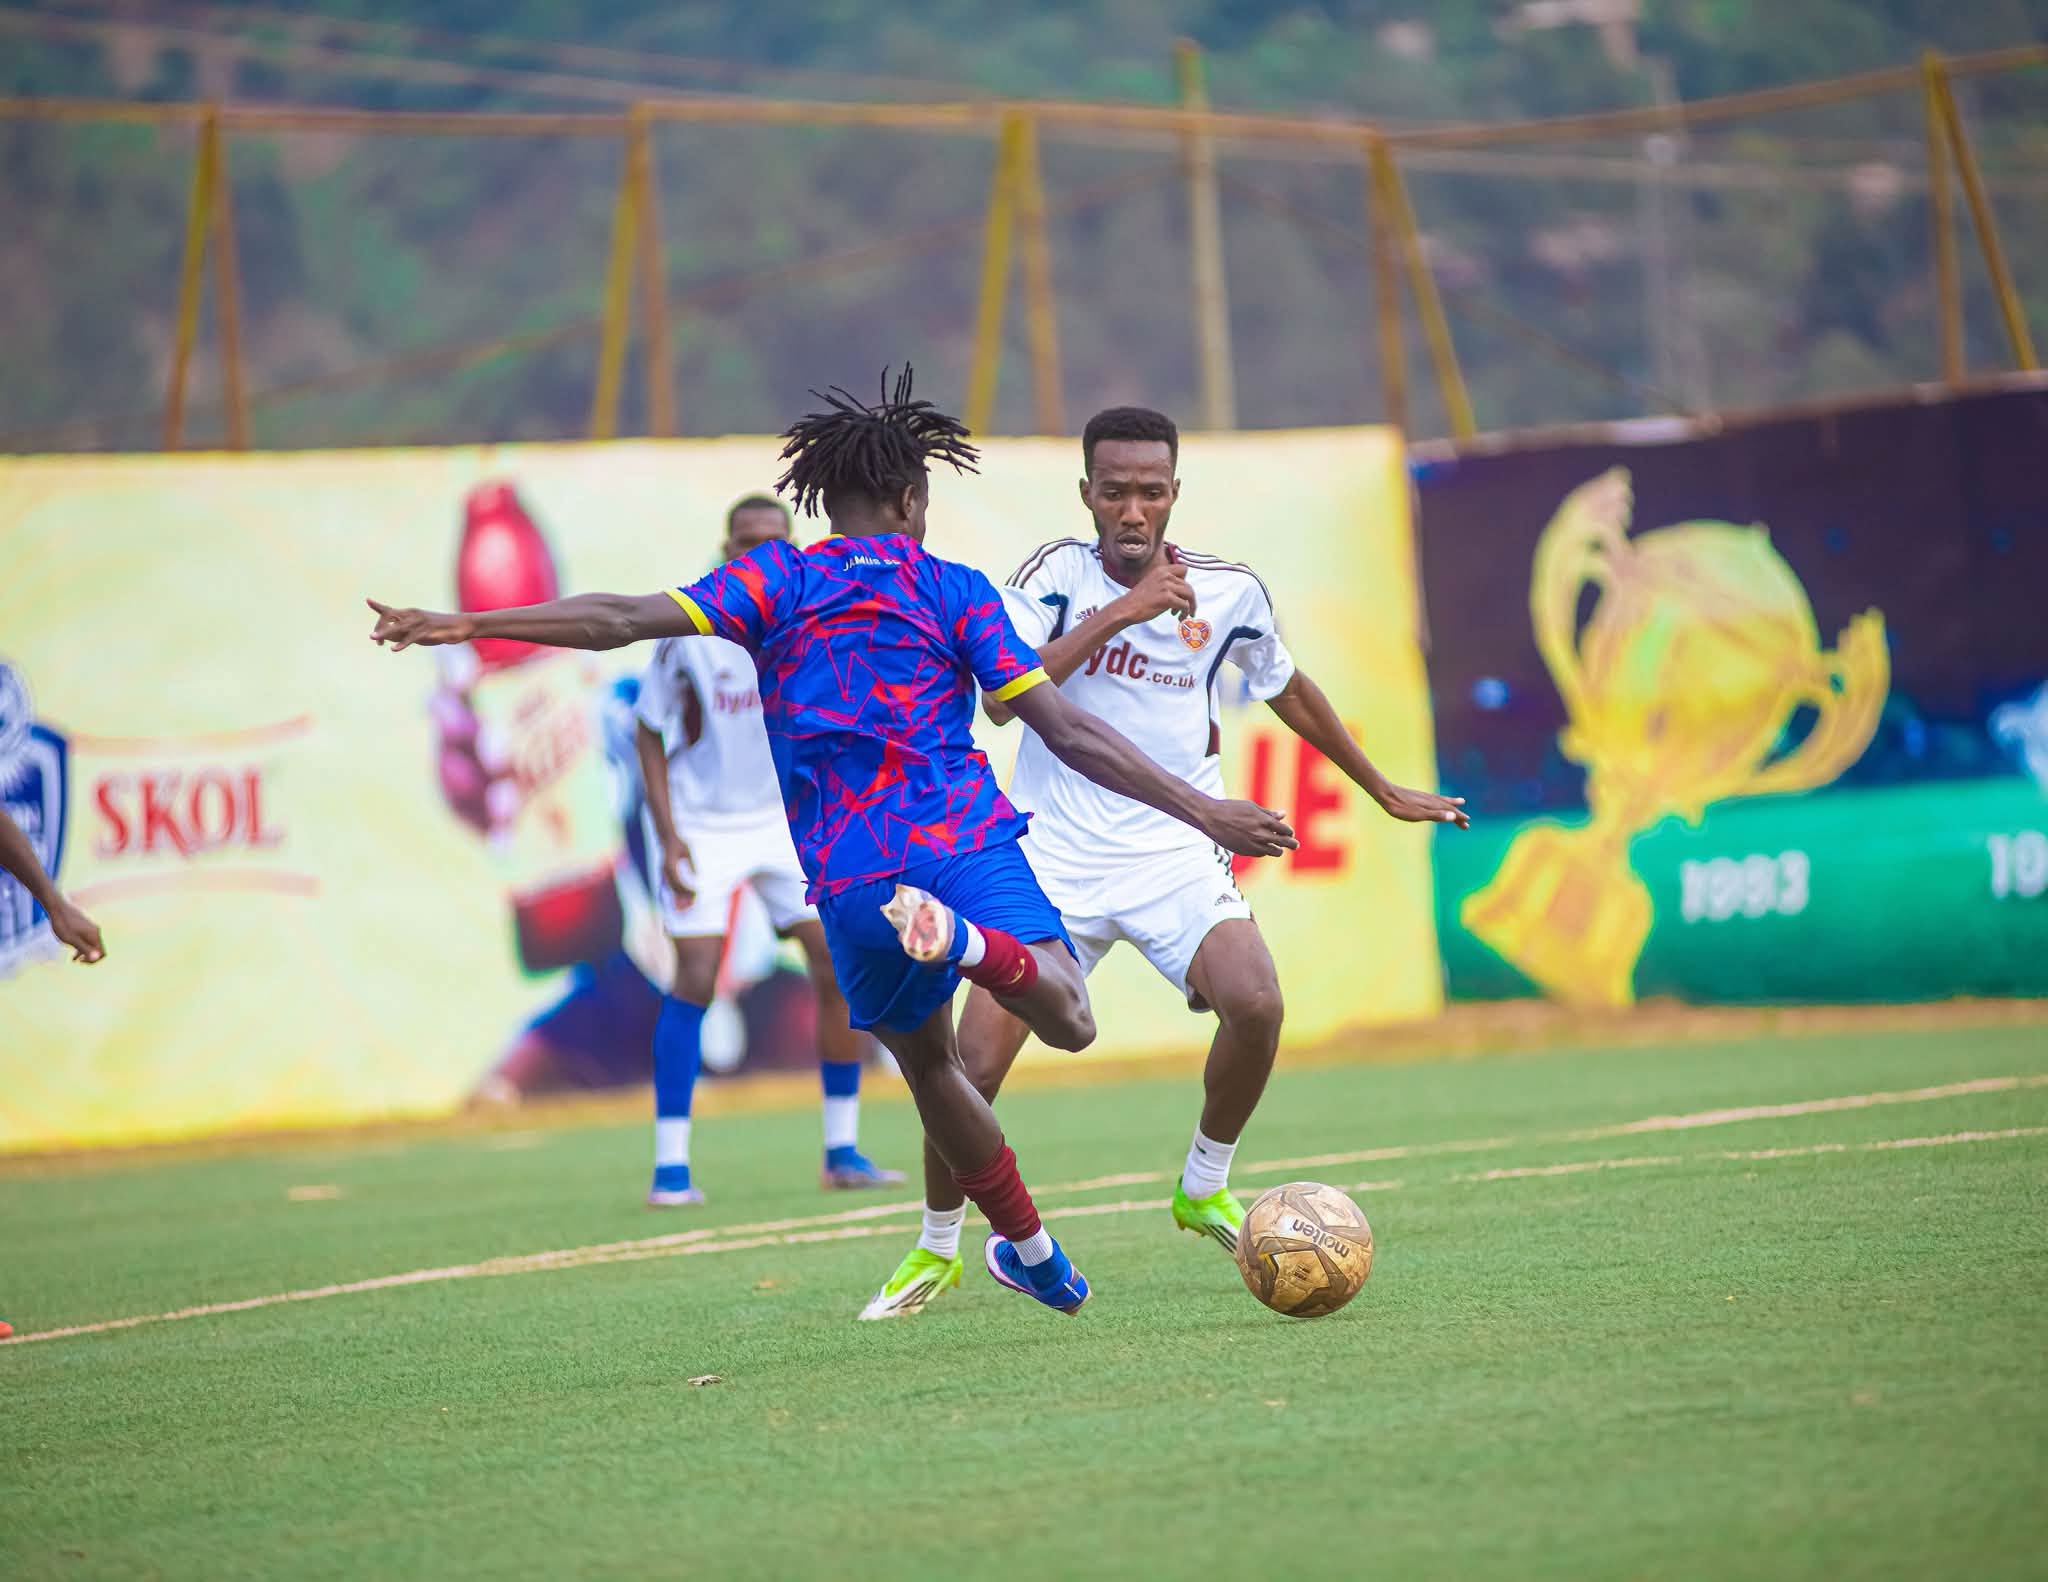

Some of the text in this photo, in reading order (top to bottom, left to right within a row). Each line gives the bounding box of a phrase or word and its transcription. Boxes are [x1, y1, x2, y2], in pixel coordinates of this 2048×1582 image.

[1084, 641, 1197, 689] ydc.co.uk
[92, 766, 285, 860] SKOL
[1292, 1218, 1350, 1259] molten
